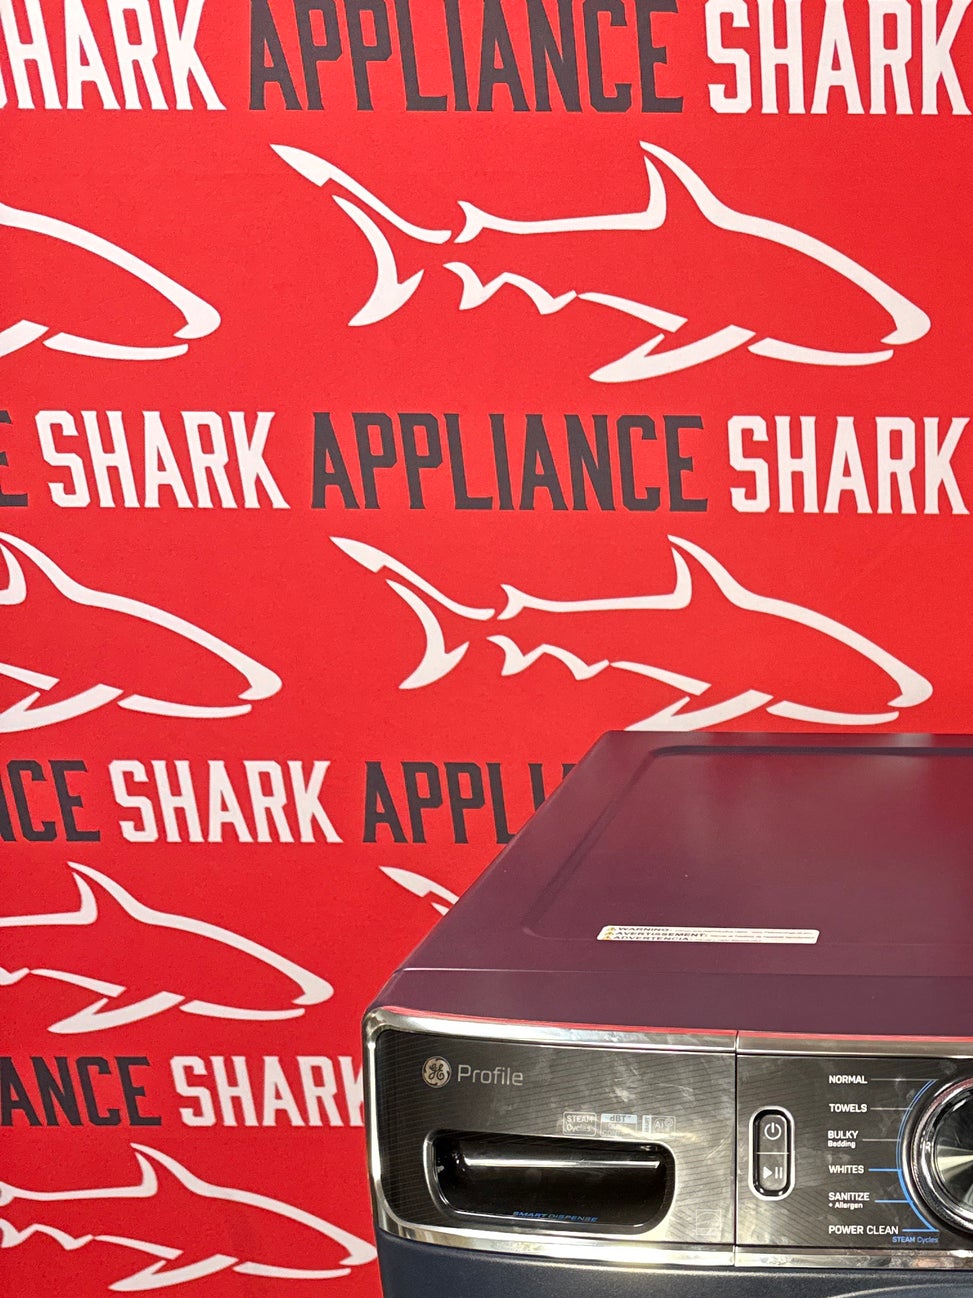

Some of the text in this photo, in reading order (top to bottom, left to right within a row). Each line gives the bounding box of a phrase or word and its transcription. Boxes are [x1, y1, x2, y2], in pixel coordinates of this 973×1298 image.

[0, 0, 227, 111] HARK
[248, 0, 685, 113] APPLIANCE
[706, 0, 972, 116] SHARK
[35, 410, 290, 509] SHARK
[310, 412, 709, 513] APPLIANCE
[728, 415, 971, 515] SHARK
[109, 759, 344, 844] SHARK
[362, 761, 577, 845] APPLI
[457, 1064, 524, 1086] Profile
[828, 1075, 868, 1085] NORMAL
[828, 1103, 868, 1113] TOWELS
[827, 1130, 859, 1139] BULKY
[827, 1140, 856, 1149] Bedding
[828, 1165, 865, 1174] WHITES
[828, 1192, 870, 1201] SANITIZE
[834, 1202, 863, 1210] Allergen
[828, 1225, 899, 1235] POWER CLEAN
[916, 1236, 939, 1245] Cycles
